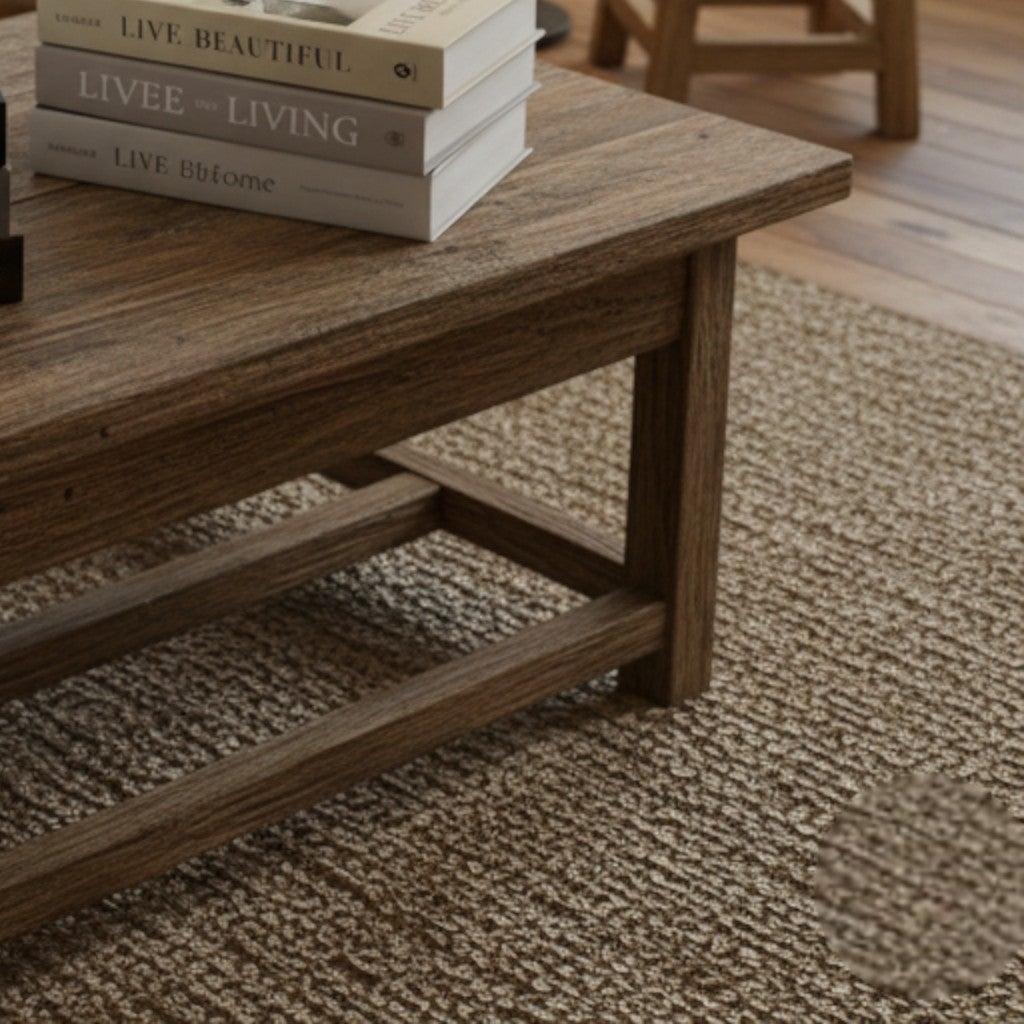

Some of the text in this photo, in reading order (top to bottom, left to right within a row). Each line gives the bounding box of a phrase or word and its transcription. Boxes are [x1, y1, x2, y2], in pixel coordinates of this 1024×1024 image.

[120, 15, 182, 47] LIVE
[193, 27, 351, 73] BEAUTIFUL
[78, 70, 360, 147] LIVEE LIVING
[114, 146, 170, 175] LIVE
